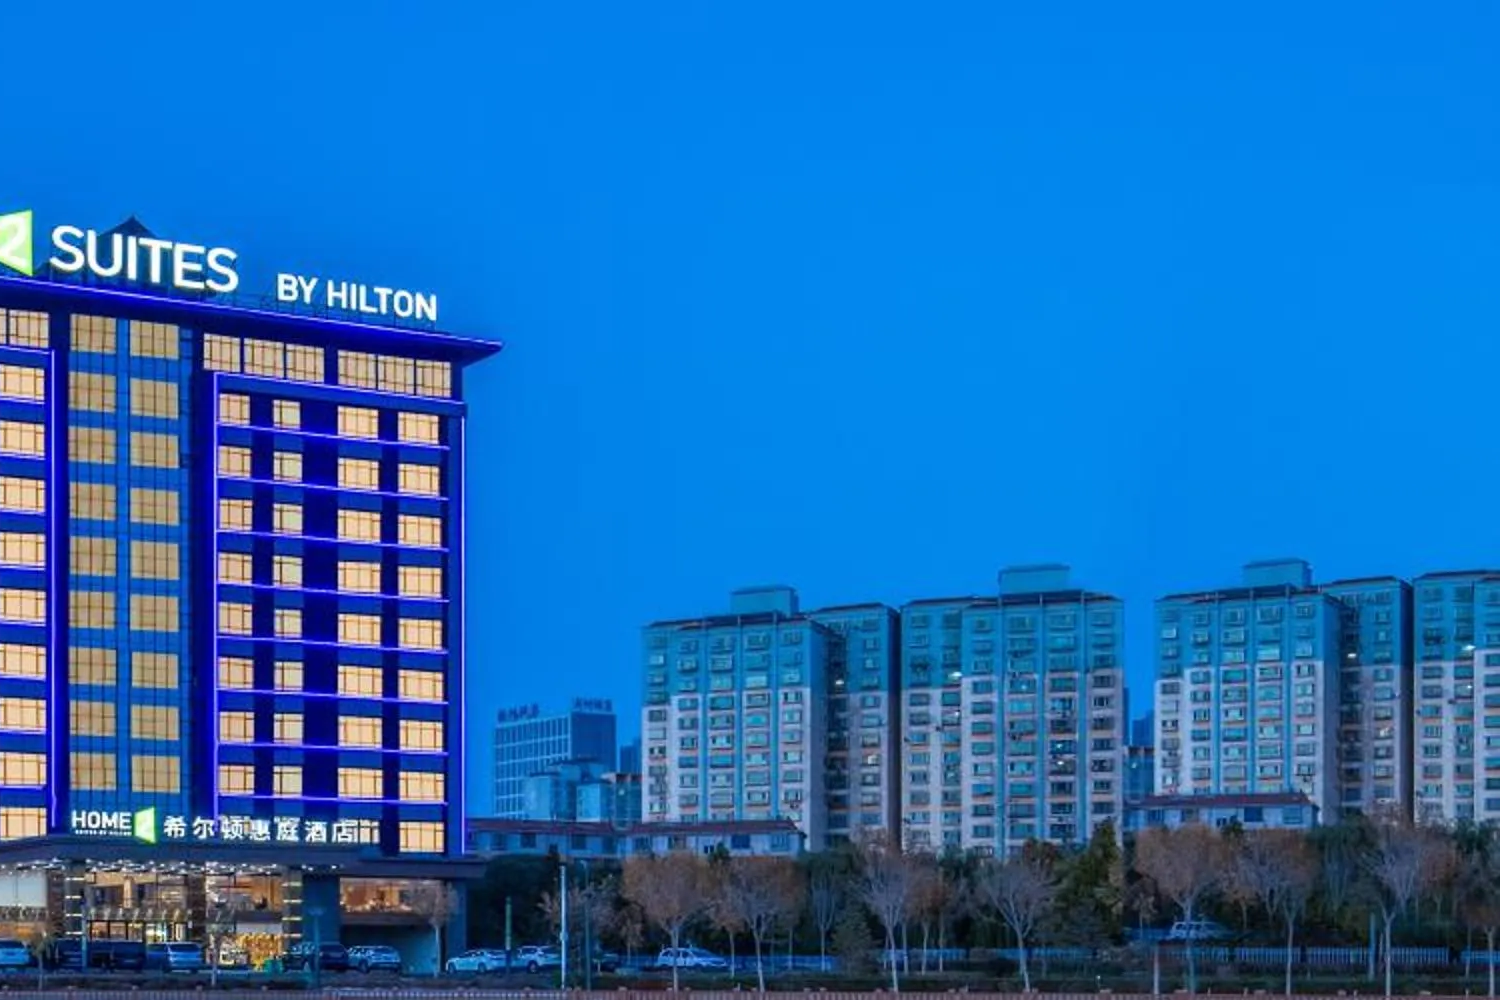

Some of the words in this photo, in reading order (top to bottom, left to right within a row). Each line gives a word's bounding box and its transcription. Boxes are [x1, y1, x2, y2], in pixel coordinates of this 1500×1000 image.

[49, 225, 239, 293] SUITES
[277, 273, 318, 304] BY
[327, 279, 437, 321] HILTON
[71, 810, 132, 829] HOME
[163, 815, 354, 843] 希尔顿惠庭酒店
